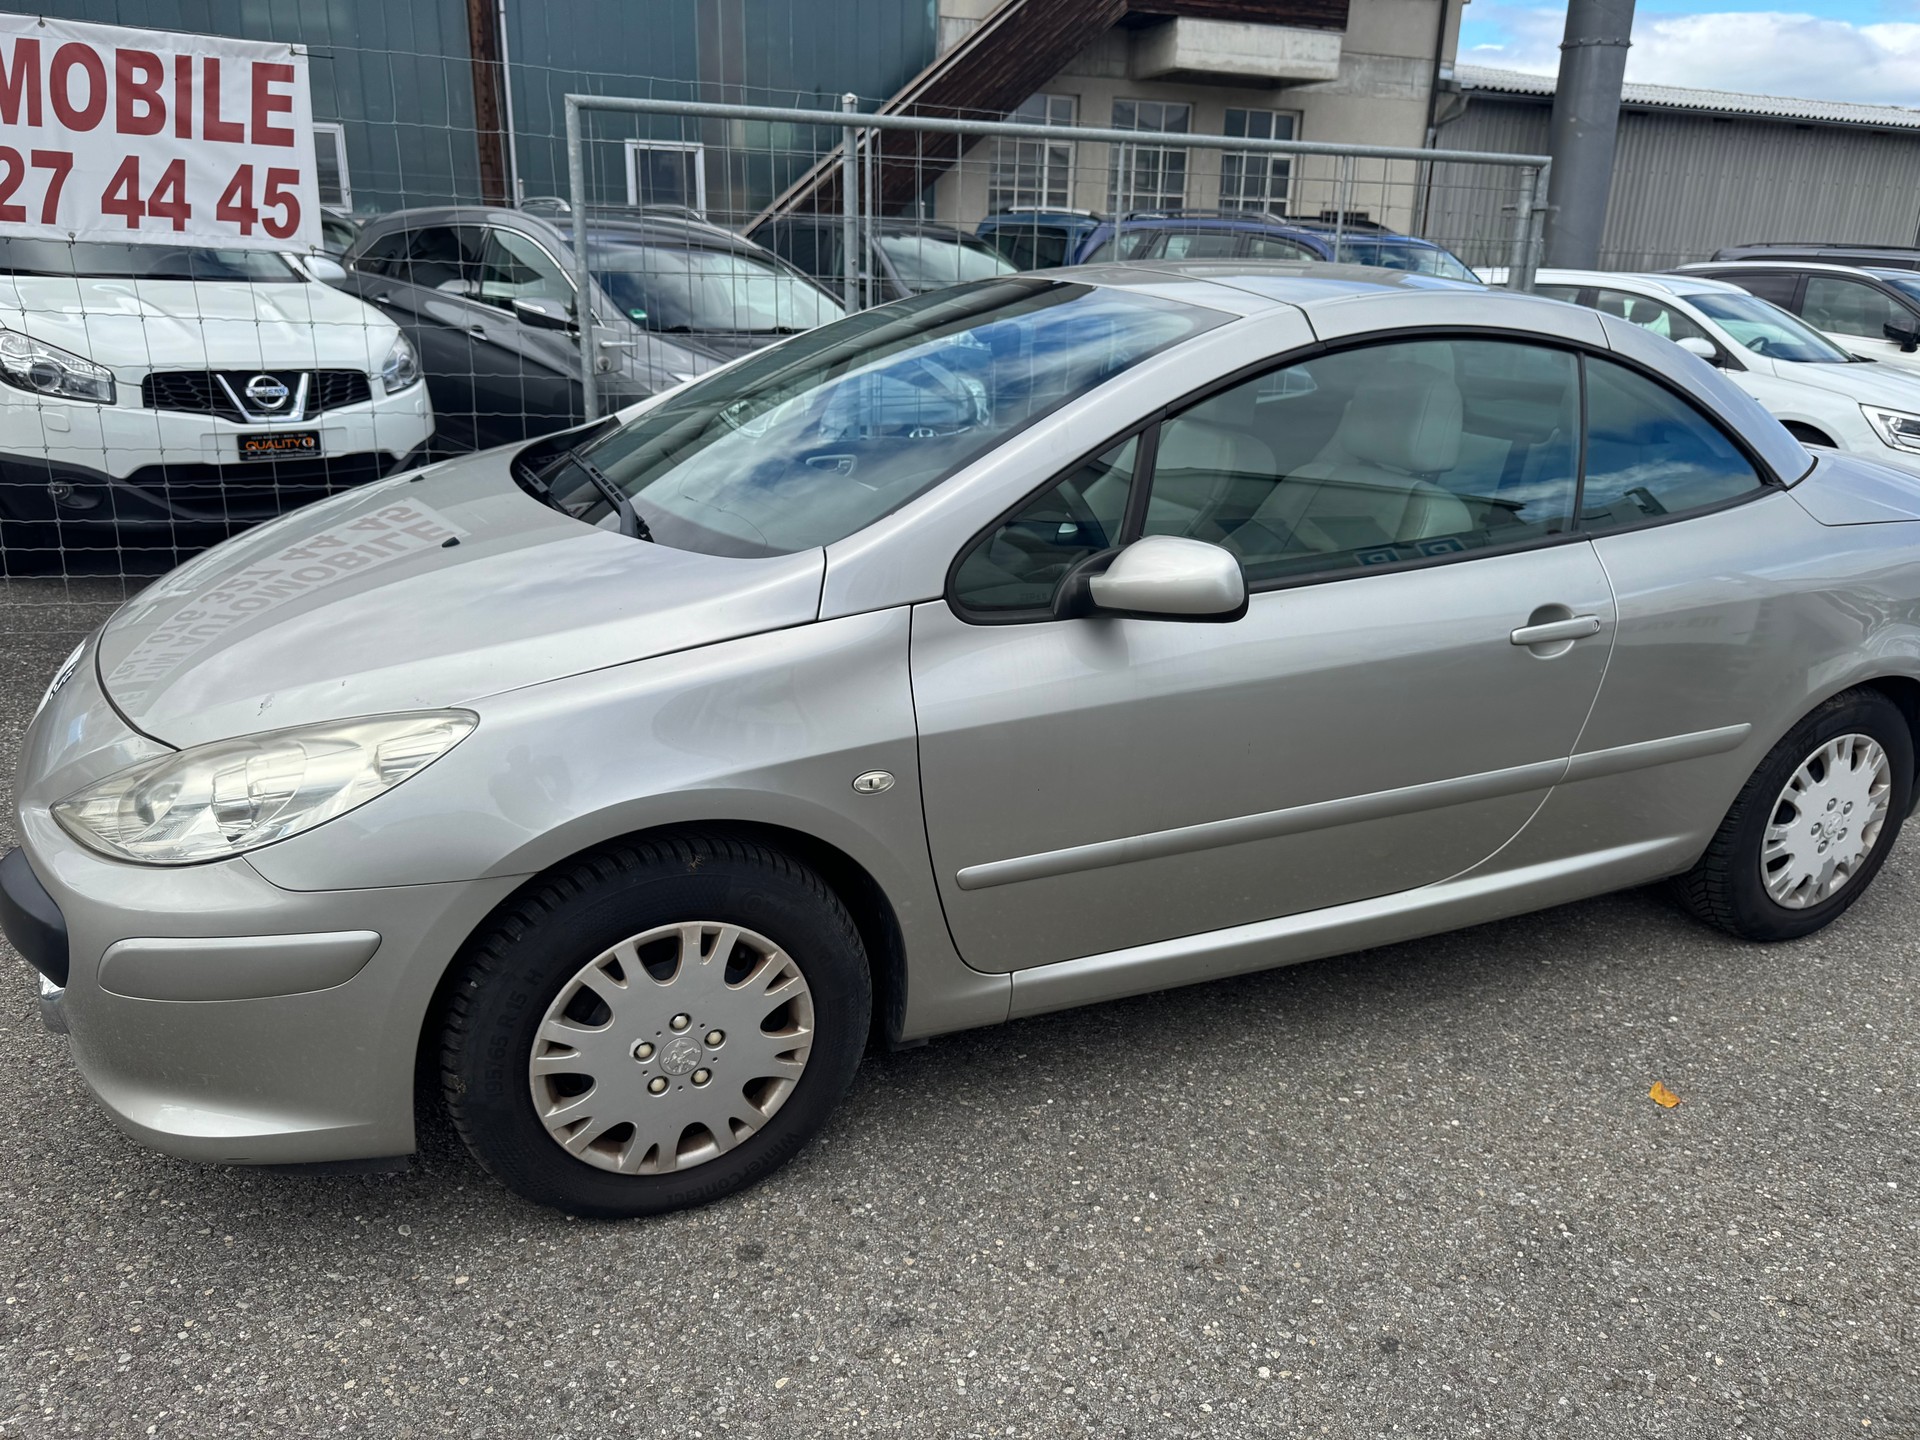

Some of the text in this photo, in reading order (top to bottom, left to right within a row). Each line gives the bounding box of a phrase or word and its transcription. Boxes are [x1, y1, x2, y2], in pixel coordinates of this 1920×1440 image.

[0, 38, 295, 148] MOBILE
[101, 155, 192, 232] 44
[216, 164, 300, 239] 45
[246, 438, 302, 450] QUALITY
